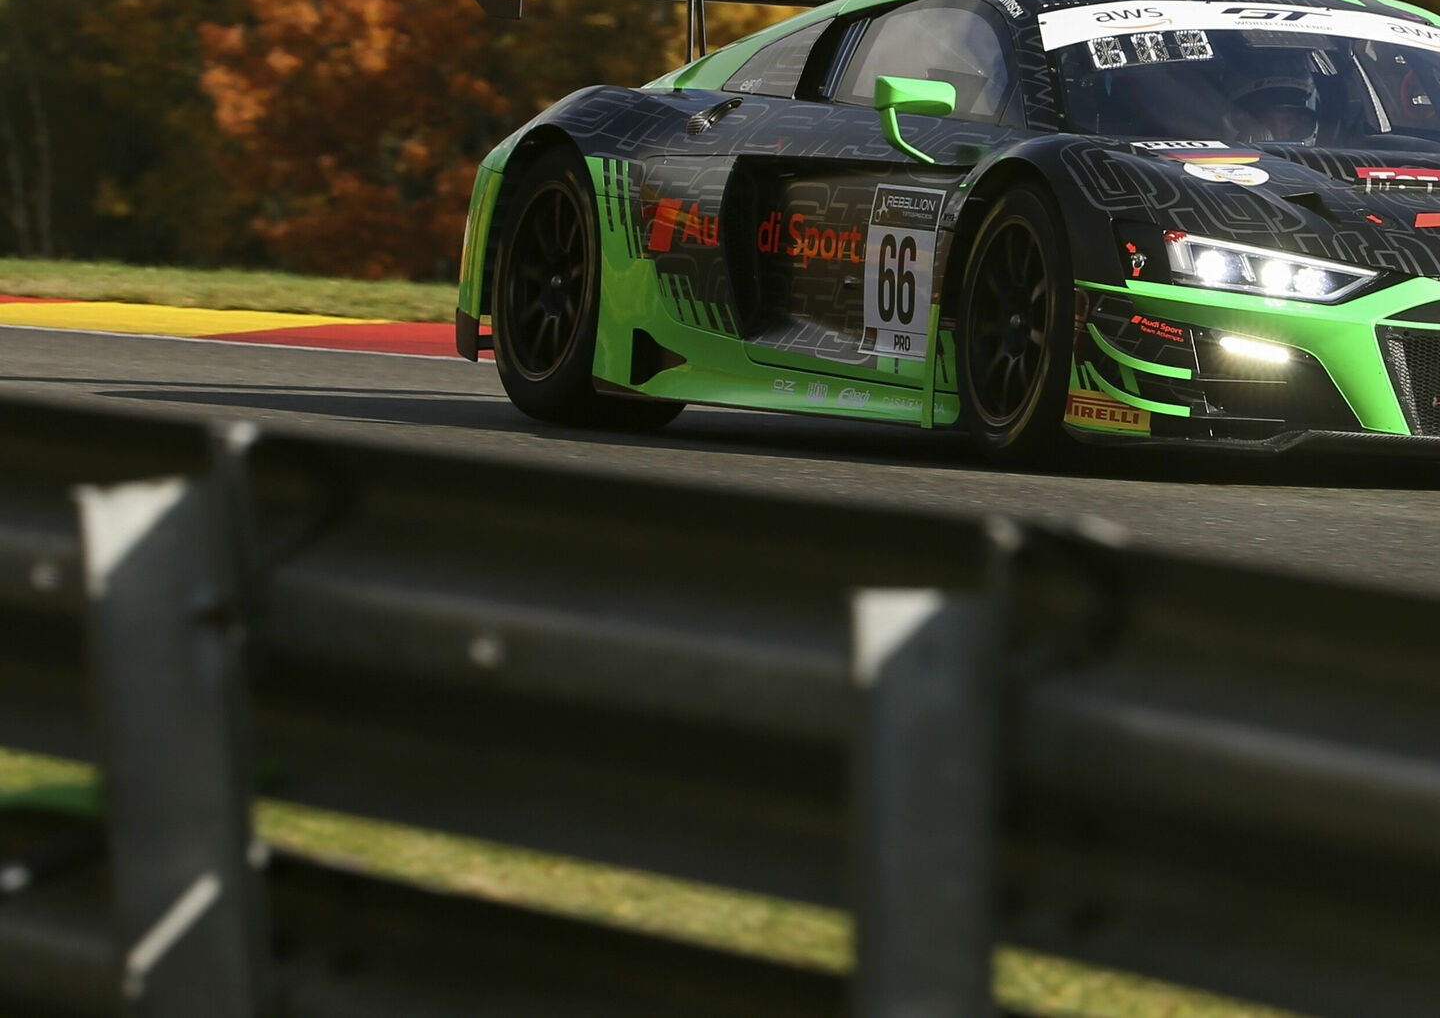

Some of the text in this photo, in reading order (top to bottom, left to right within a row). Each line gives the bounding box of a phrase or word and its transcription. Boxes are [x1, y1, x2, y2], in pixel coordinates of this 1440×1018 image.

[1093, 7, 1164, 23] aws
[1222, 7, 1333, 21] GT
[1274, 21, 1333, 31] CHALLENGE
[787, 213, 862, 269] Sport
[878, 233, 917, 325] 66
[1140, 317, 1183, 335] Audi Sport
[893, 334, 911, 352] PRO
[773, 378, 796, 391] OZ
